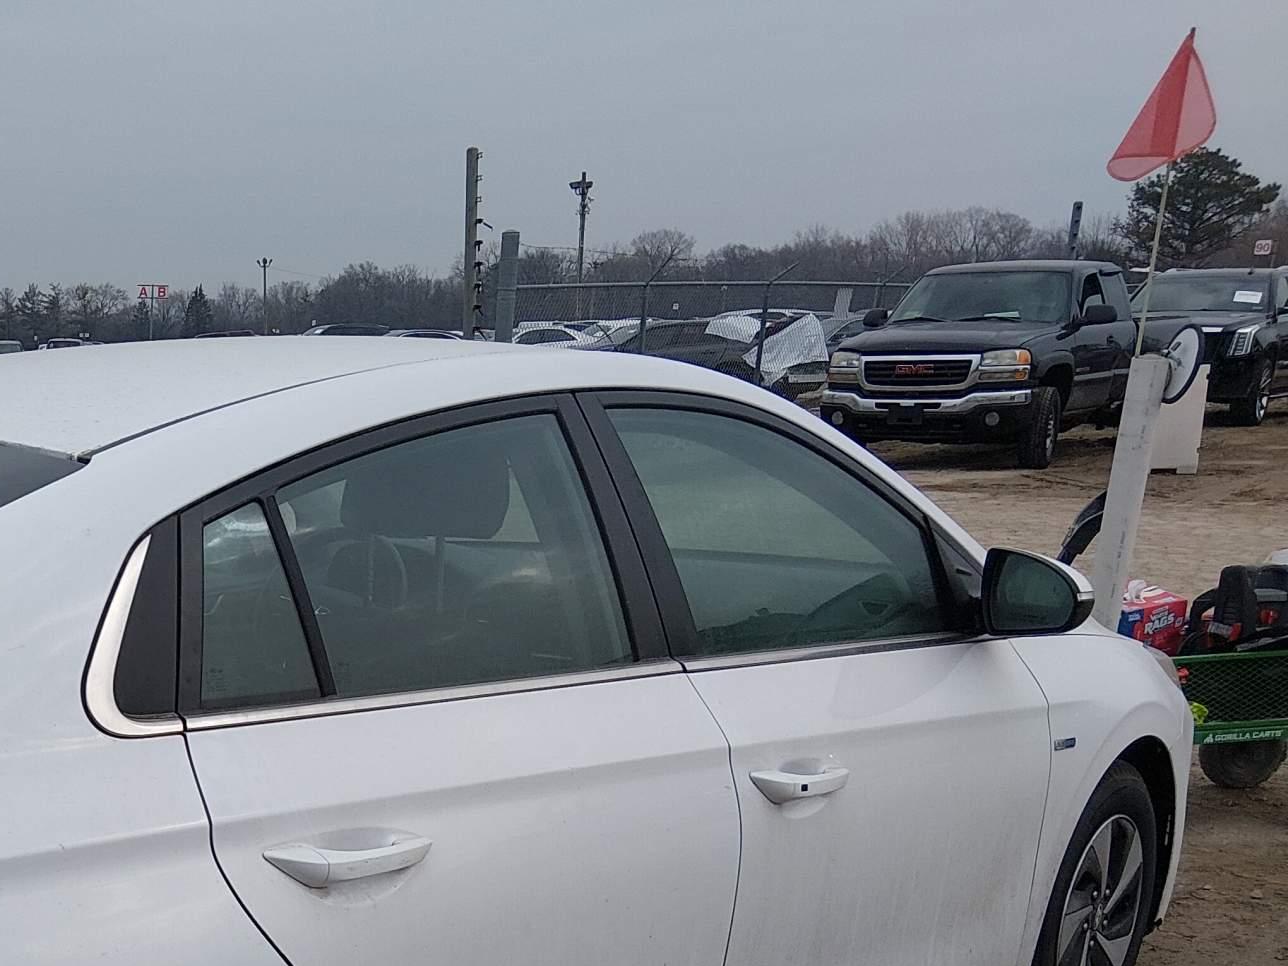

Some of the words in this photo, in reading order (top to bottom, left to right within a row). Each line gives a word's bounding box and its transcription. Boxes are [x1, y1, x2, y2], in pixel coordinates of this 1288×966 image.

[1256, 243, 1270, 253] 90
[139, 286, 148, 298] A
[158, 287, 166, 298] B
[895, 364, 935, 376] GMC
[1144, 612, 1176, 635] RAGS
[1214, 732, 1252, 742] GORILLA
